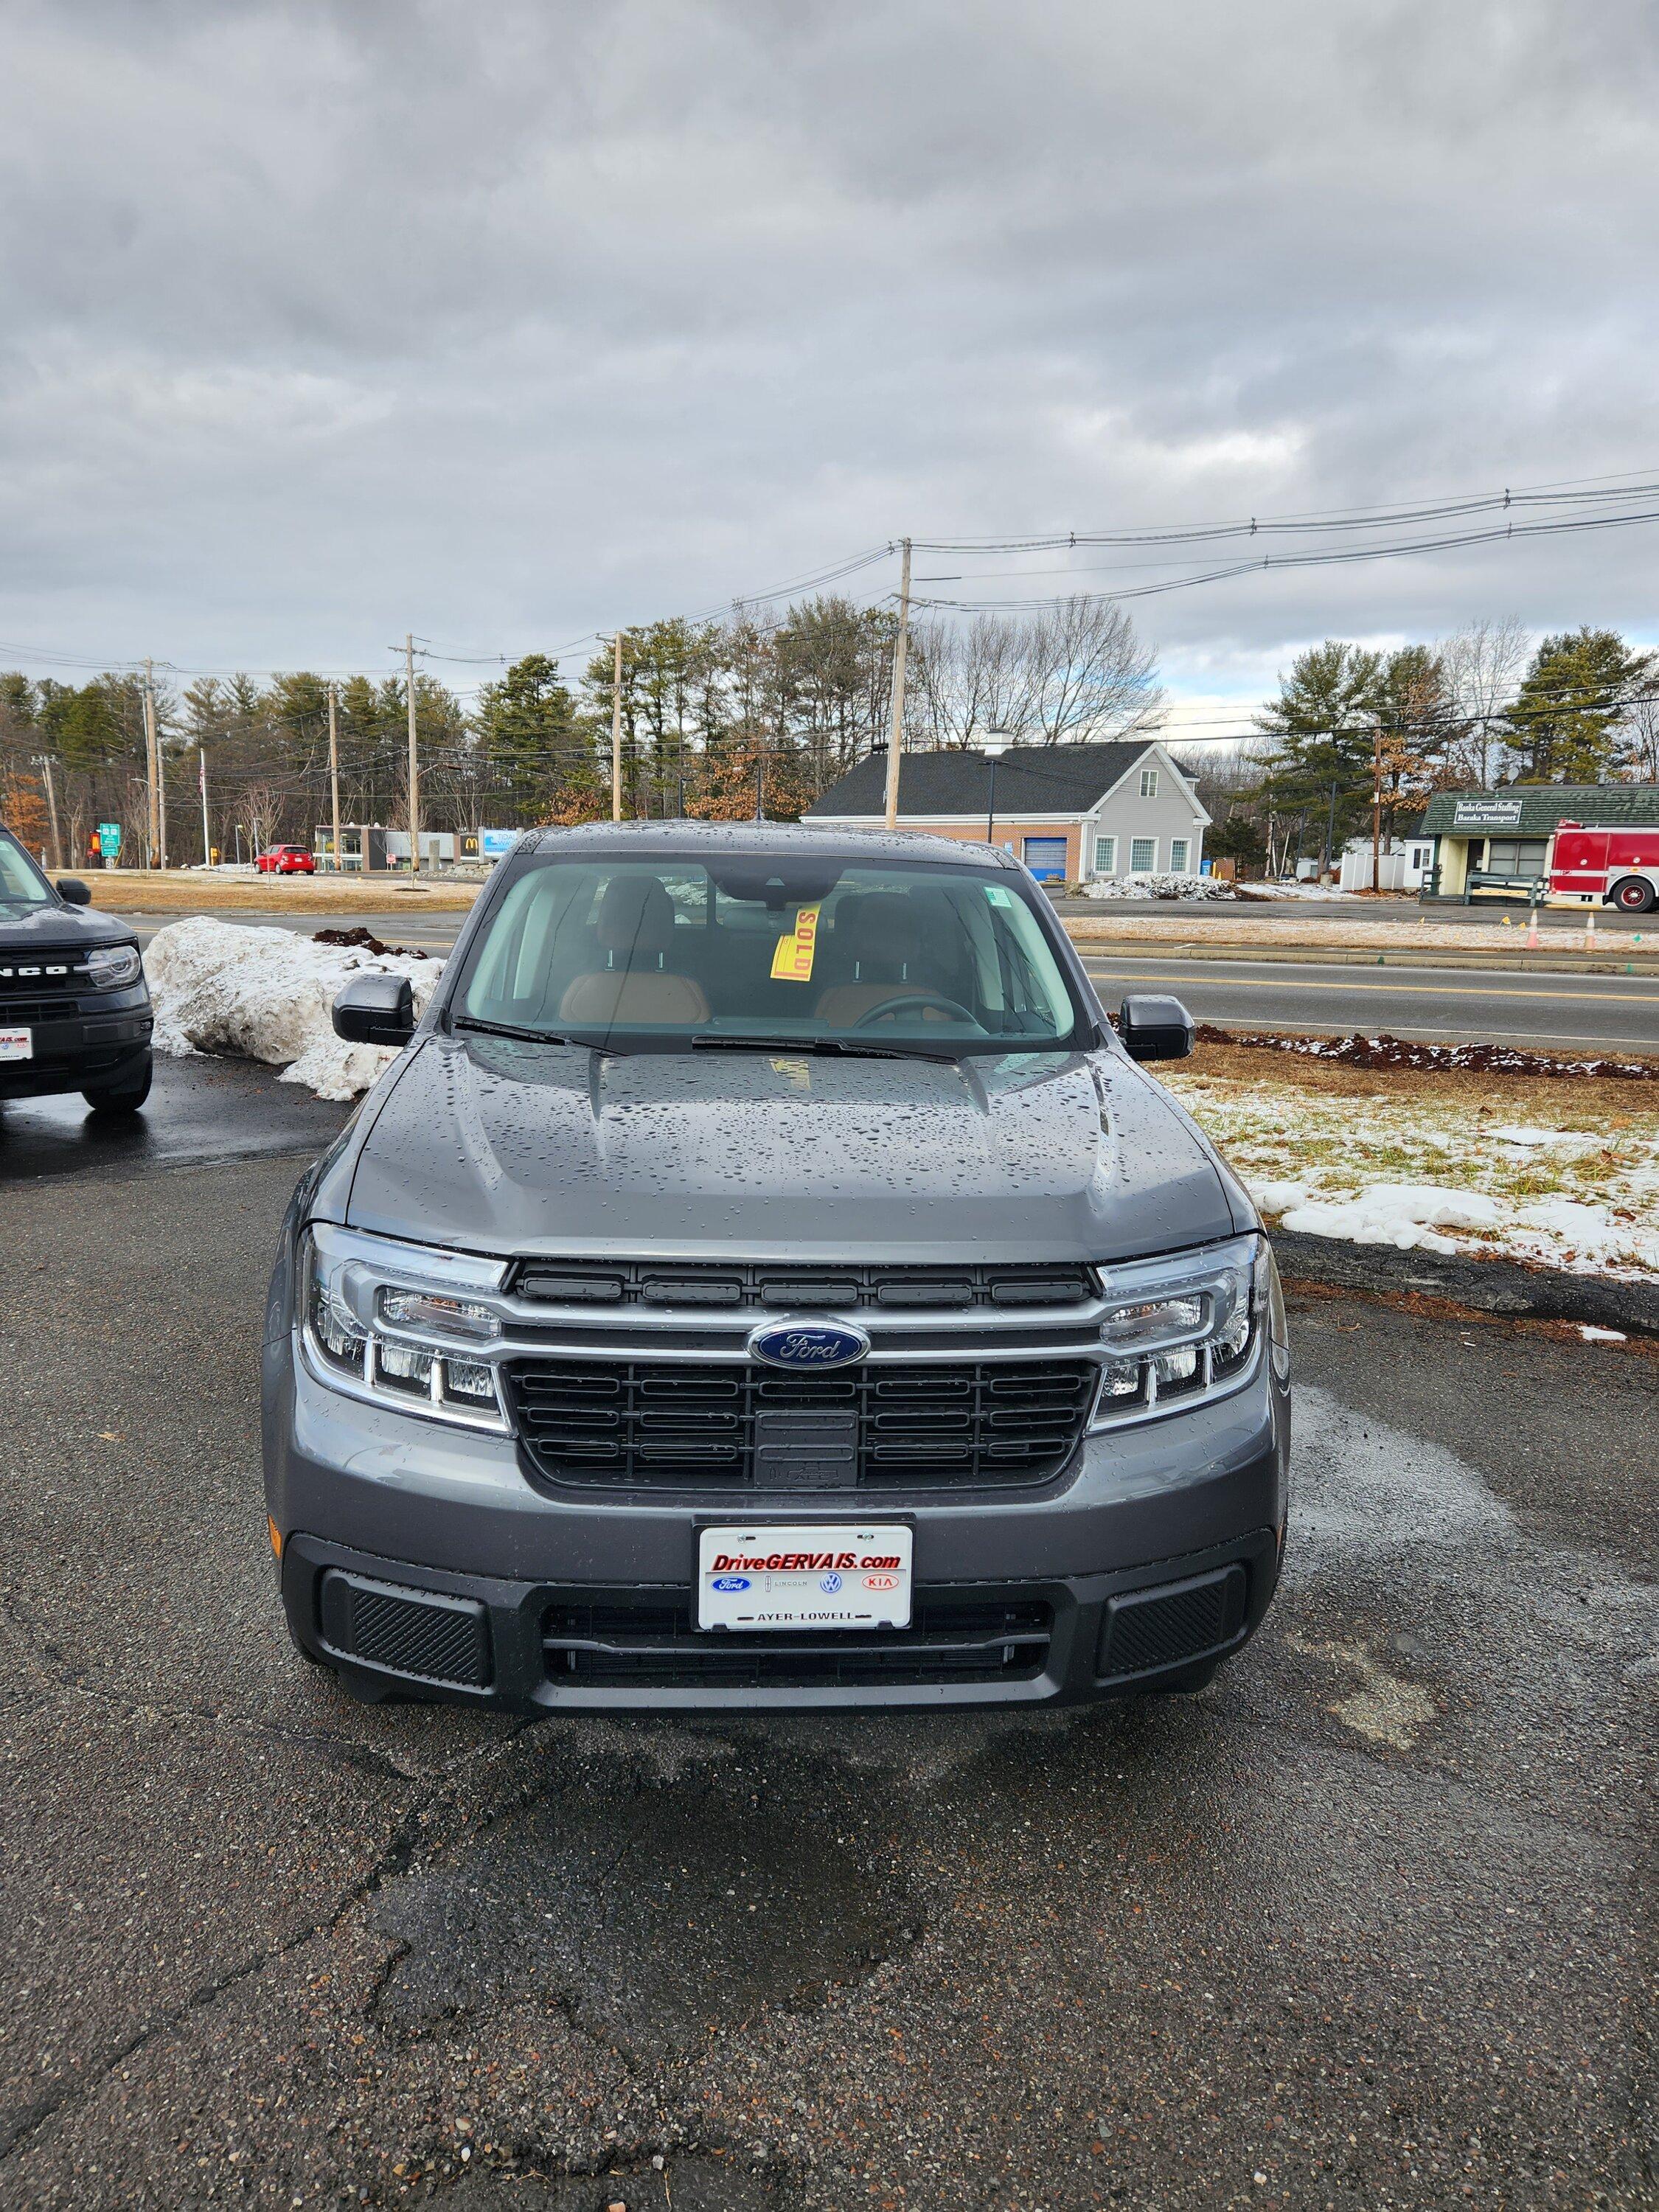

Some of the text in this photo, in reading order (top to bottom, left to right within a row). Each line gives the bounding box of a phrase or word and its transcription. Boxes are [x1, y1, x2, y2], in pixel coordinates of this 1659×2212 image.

[1476, 803, 1498, 812] General
[1498, 802, 1520, 814] Staffing
[1481, 813, 1517, 823] Transport
[794, 911, 816, 970] SOLD
[779, 1333, 841, 1359] Ford
[711, 1553, 901, 1571] DriveGERVAIS.com
[719, 1578, 743, 1590] Ford
[869, 1579, 893, 1587] KIA
[757, 1613, 854, 1621] AYER-LOWELL
